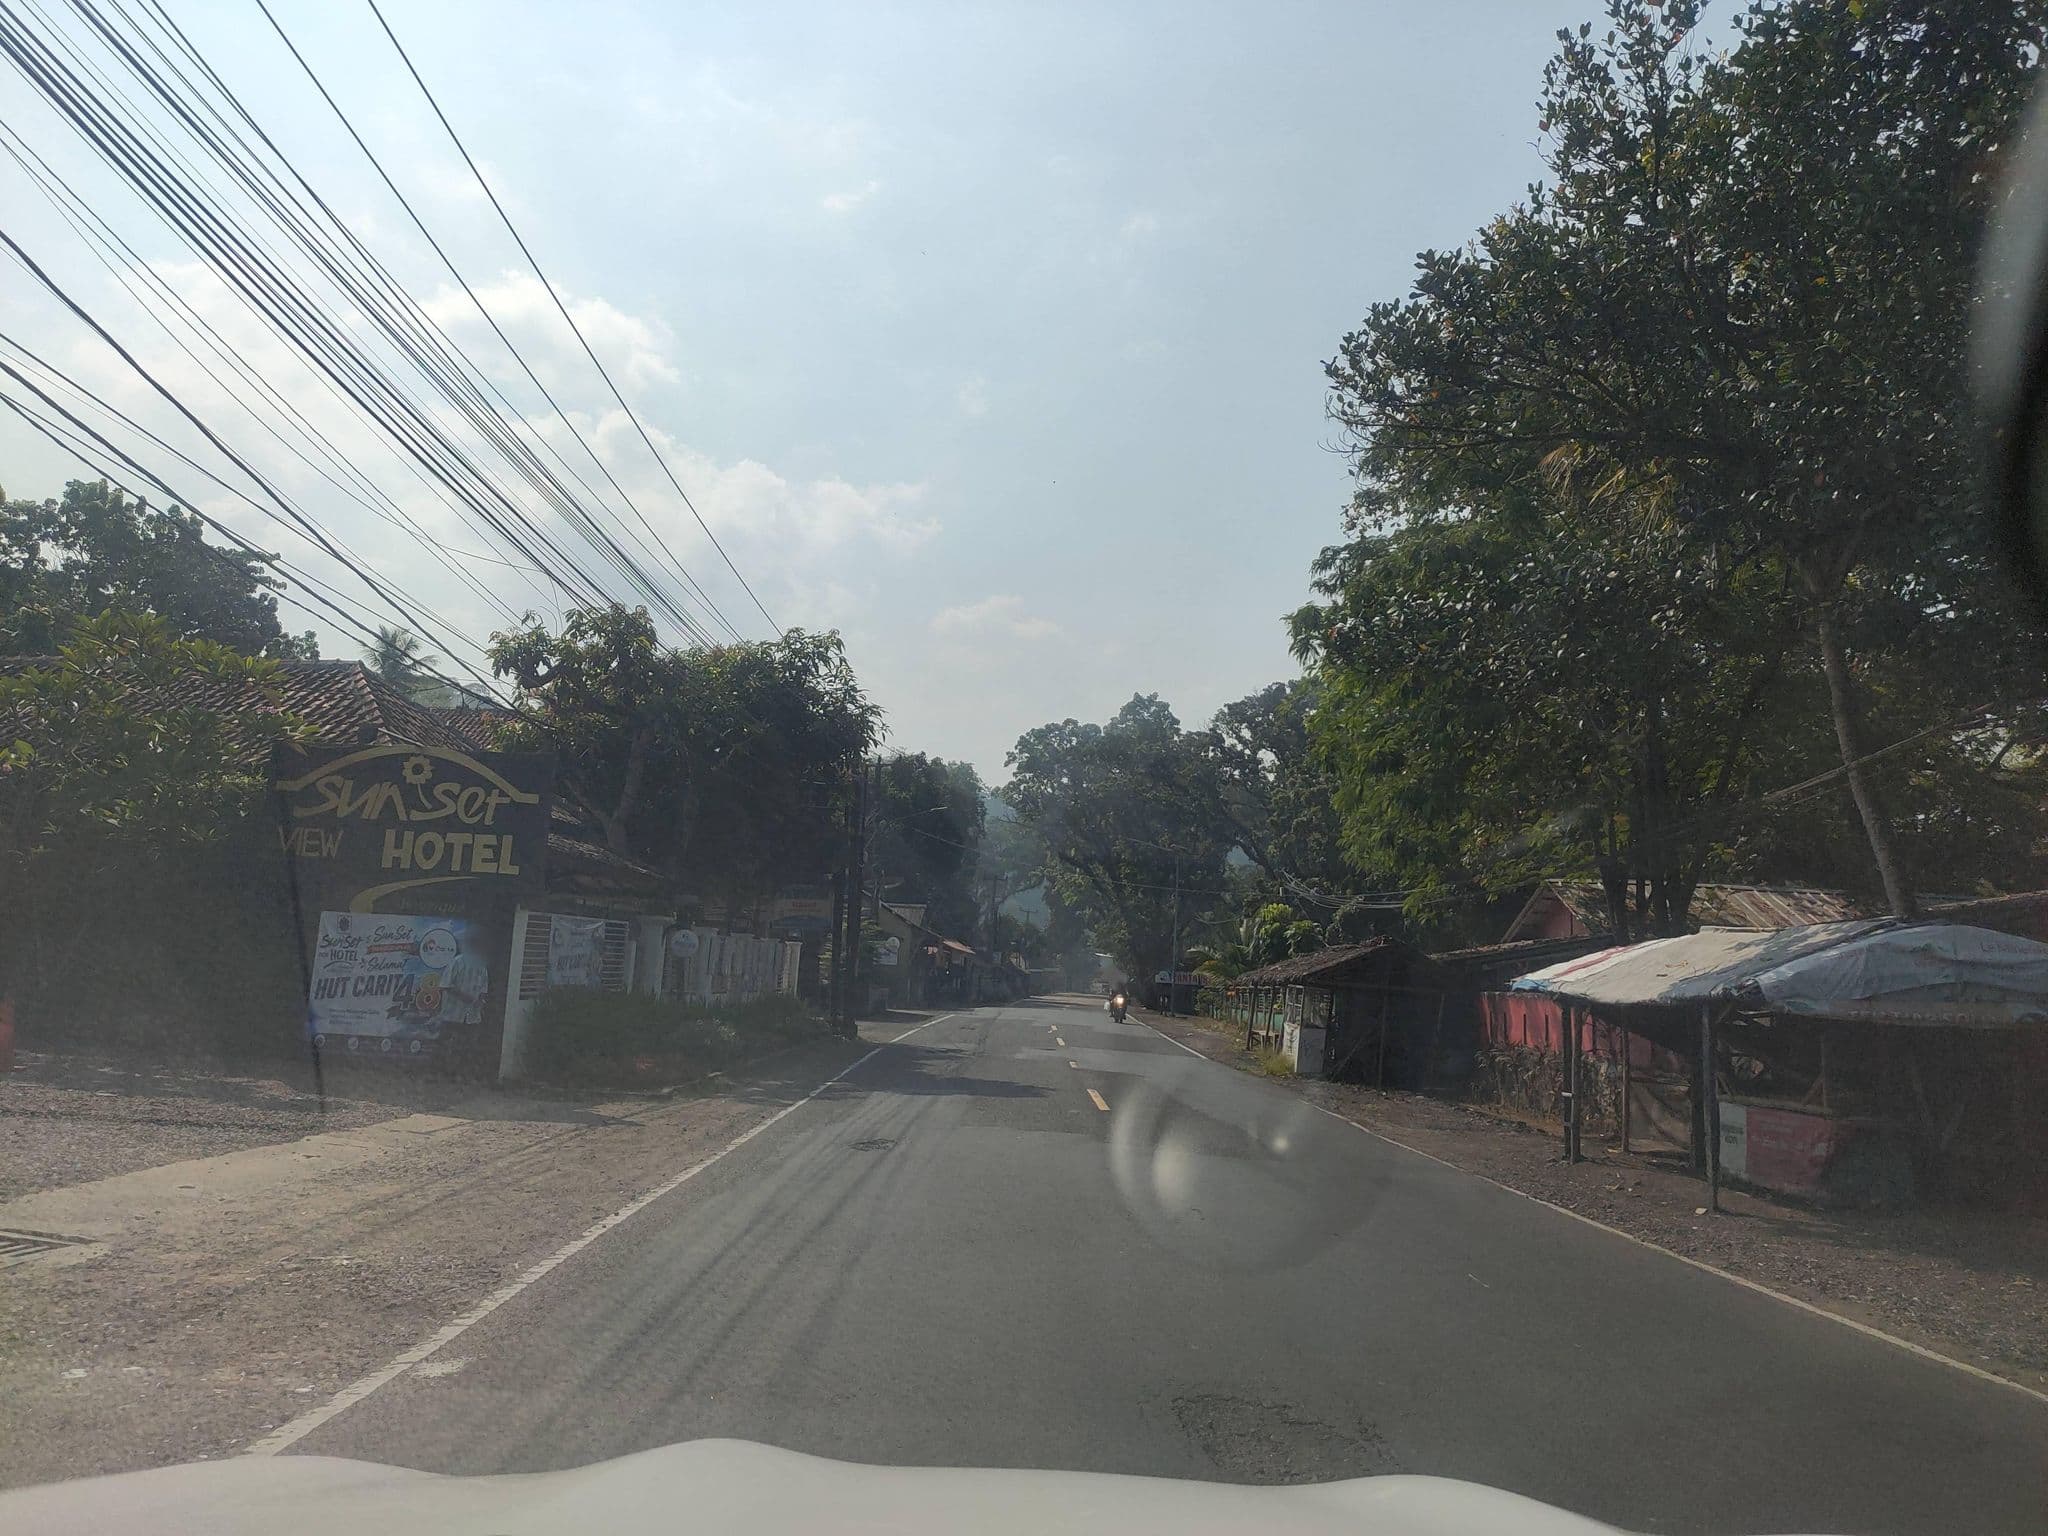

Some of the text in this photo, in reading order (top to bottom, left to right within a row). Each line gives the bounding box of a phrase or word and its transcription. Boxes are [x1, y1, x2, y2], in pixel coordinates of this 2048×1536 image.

[278, 824, 520, 875] VIEW HOTEL
[330, 949, 359, 962] HOTEL
[314, 976, 351, 1000] HUT
